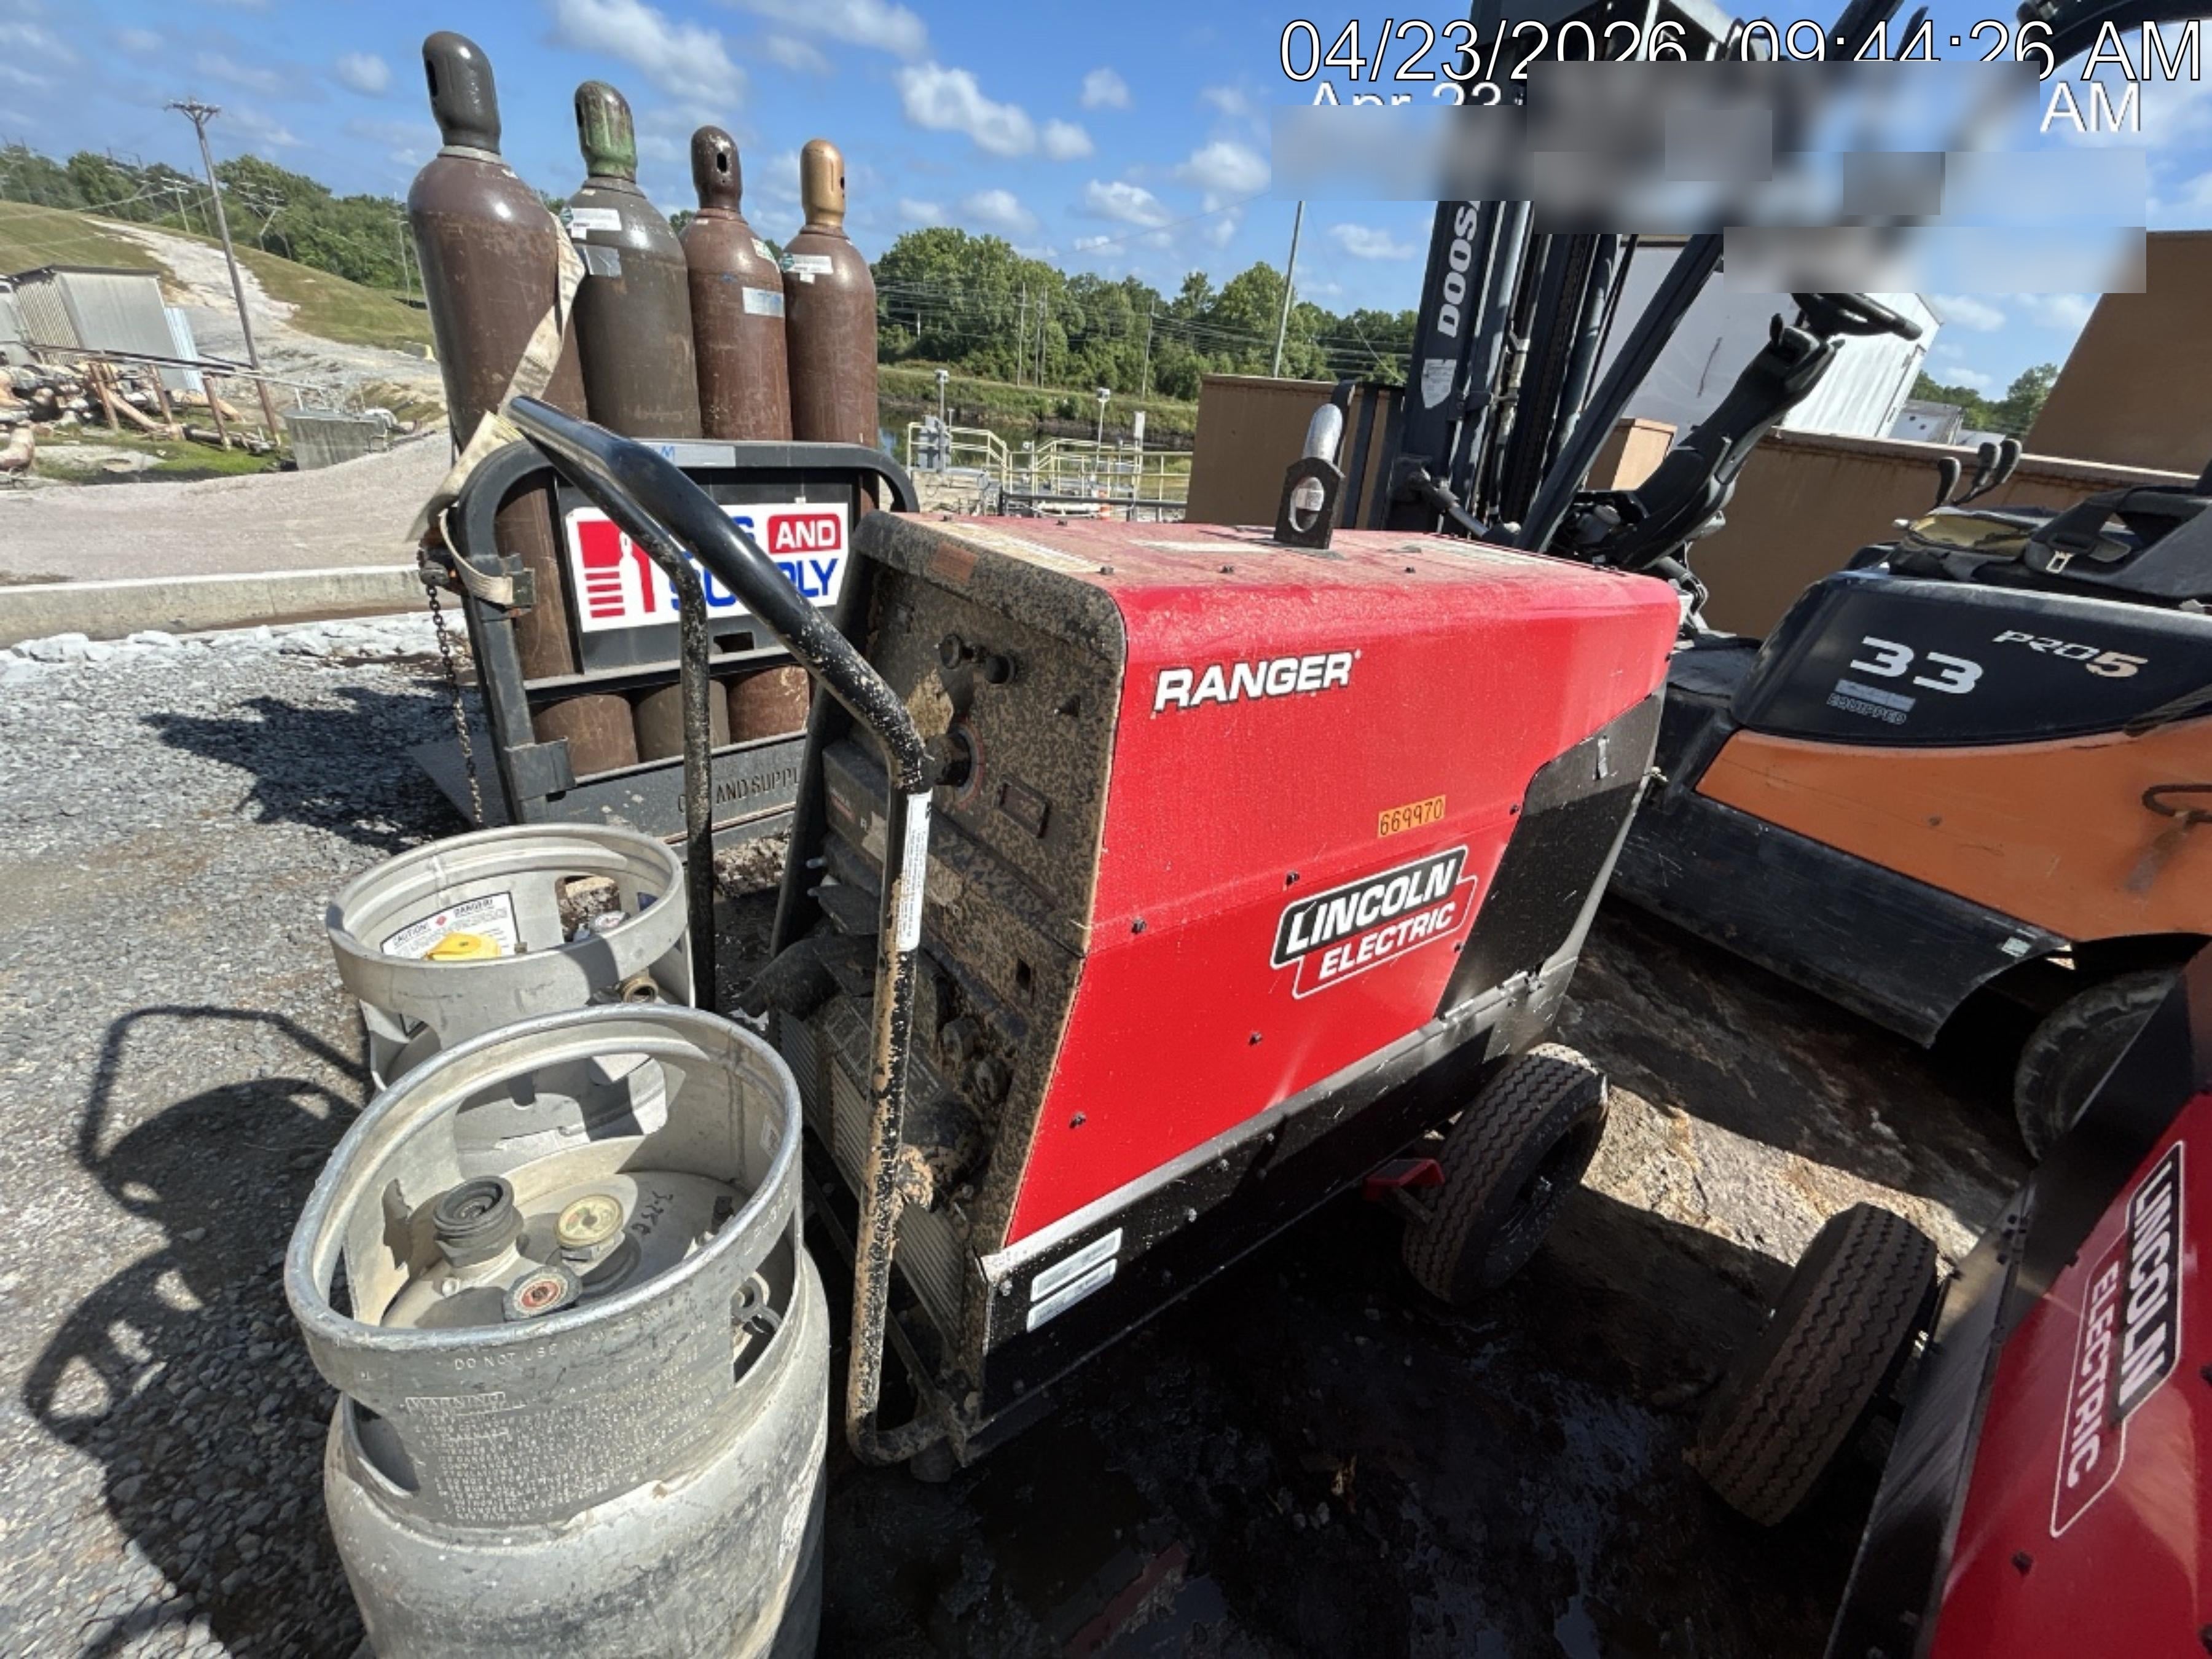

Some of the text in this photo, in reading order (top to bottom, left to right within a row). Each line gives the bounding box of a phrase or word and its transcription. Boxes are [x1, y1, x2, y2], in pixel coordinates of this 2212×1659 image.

[1437, 201, 1481, 338] DOOS
[775, 520, 836, 550] AND
[1153, 651, 1353, 714] RANGER
[1850, 635, 1983, 694] 33
[716, 779, 748, 805] AND
[751, 766, 800, 796] SUPPL
[1379, 798, 1444, 836] 669970
[1285, 858, 1457, 955] LINCOLN
[1318, 901, 1456, 981] ELECTRIC
[2117, 1160, 2173, 1408] LINCOLN
[2066, 1260, 2120, 1488] ELECTRIC
